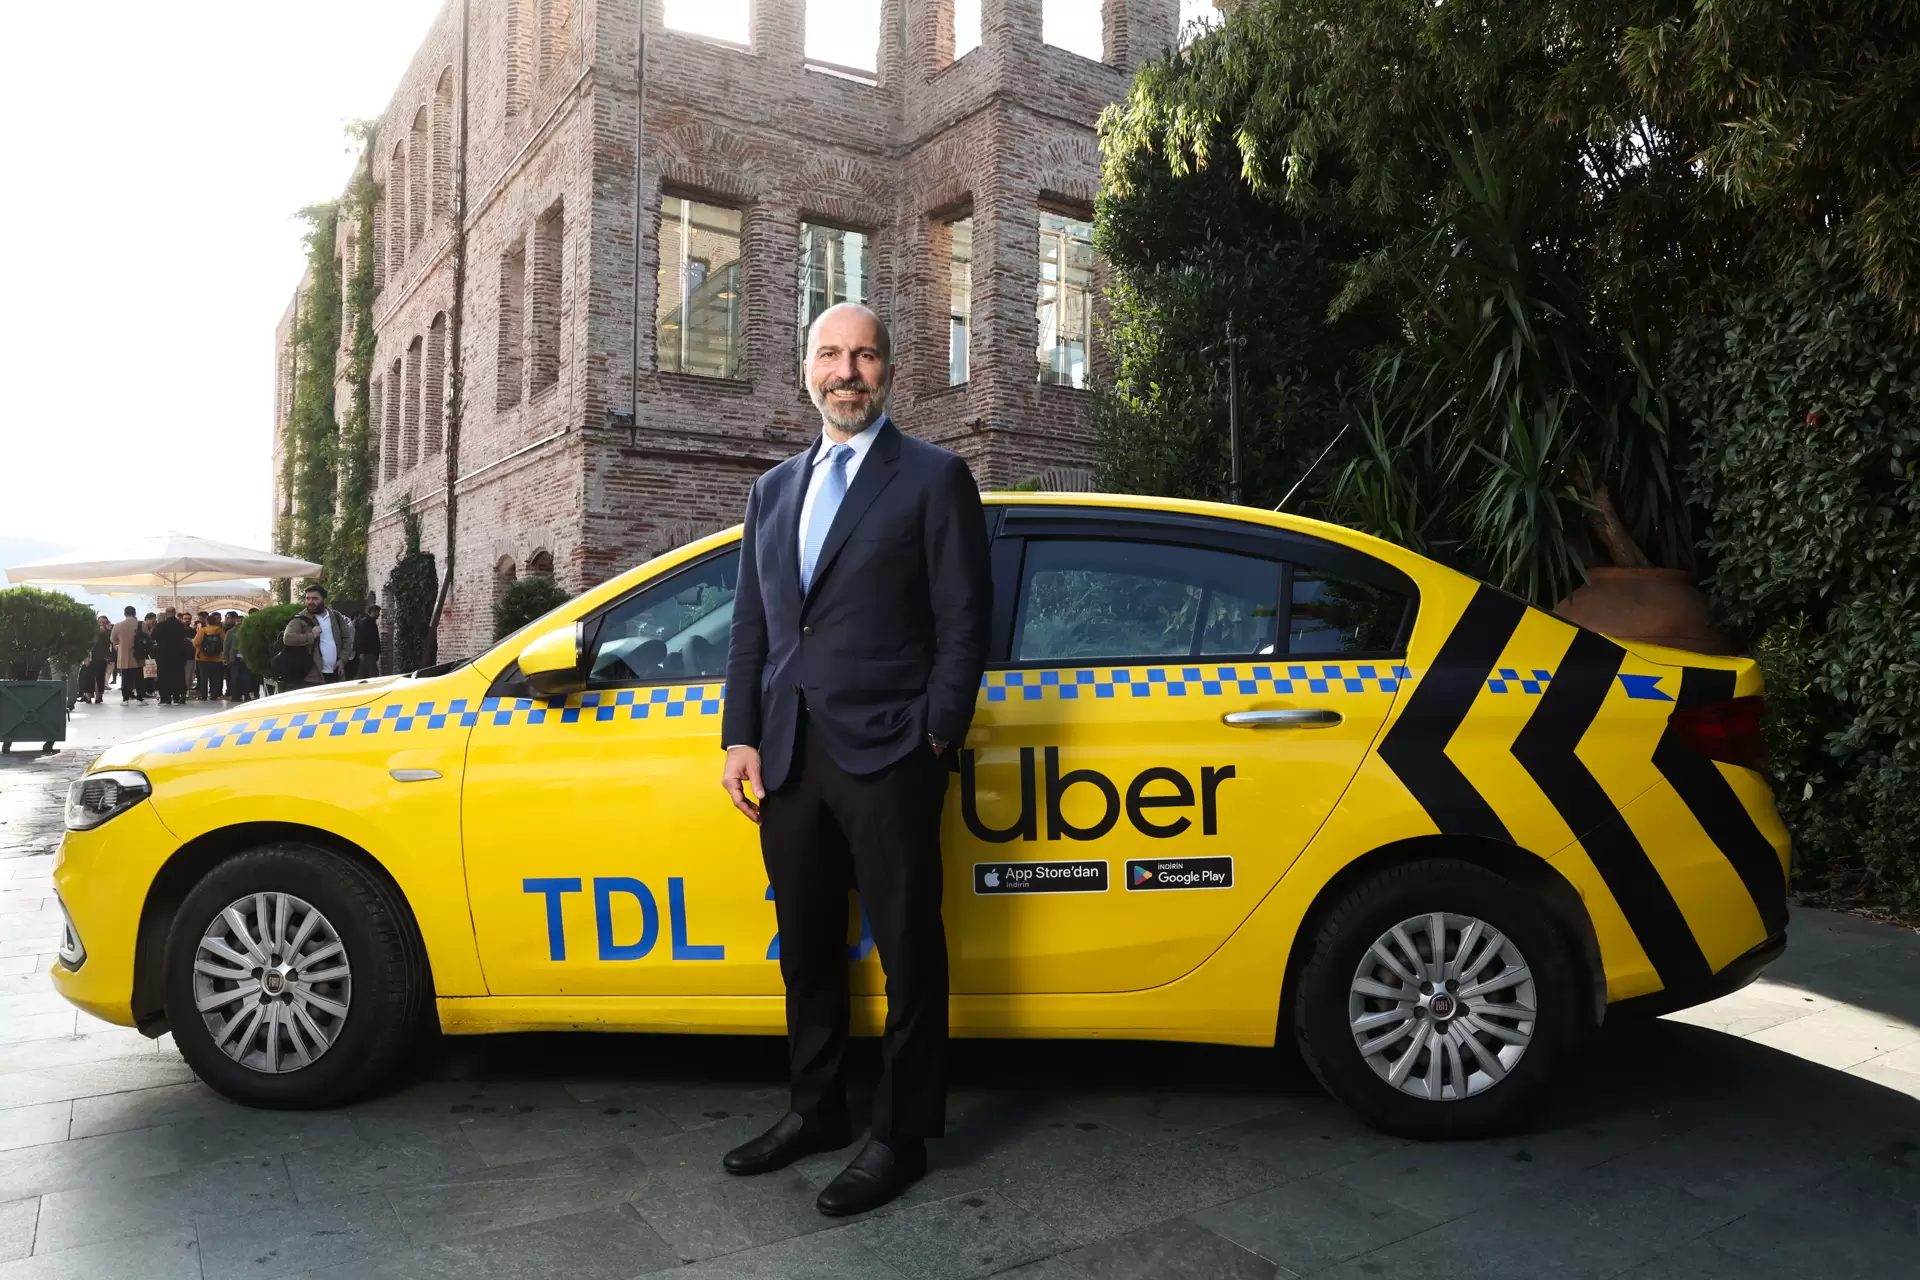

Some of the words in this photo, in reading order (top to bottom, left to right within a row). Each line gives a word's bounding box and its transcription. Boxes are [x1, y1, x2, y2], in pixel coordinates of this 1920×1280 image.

[959, 746, 1236, 843] Uber
[1005, 867, 1033, 881] App
[1158, 871, 1200, 885] Google
[1202, 870, 1225, 883] Play
[522, 876, 725, 961] TDL
